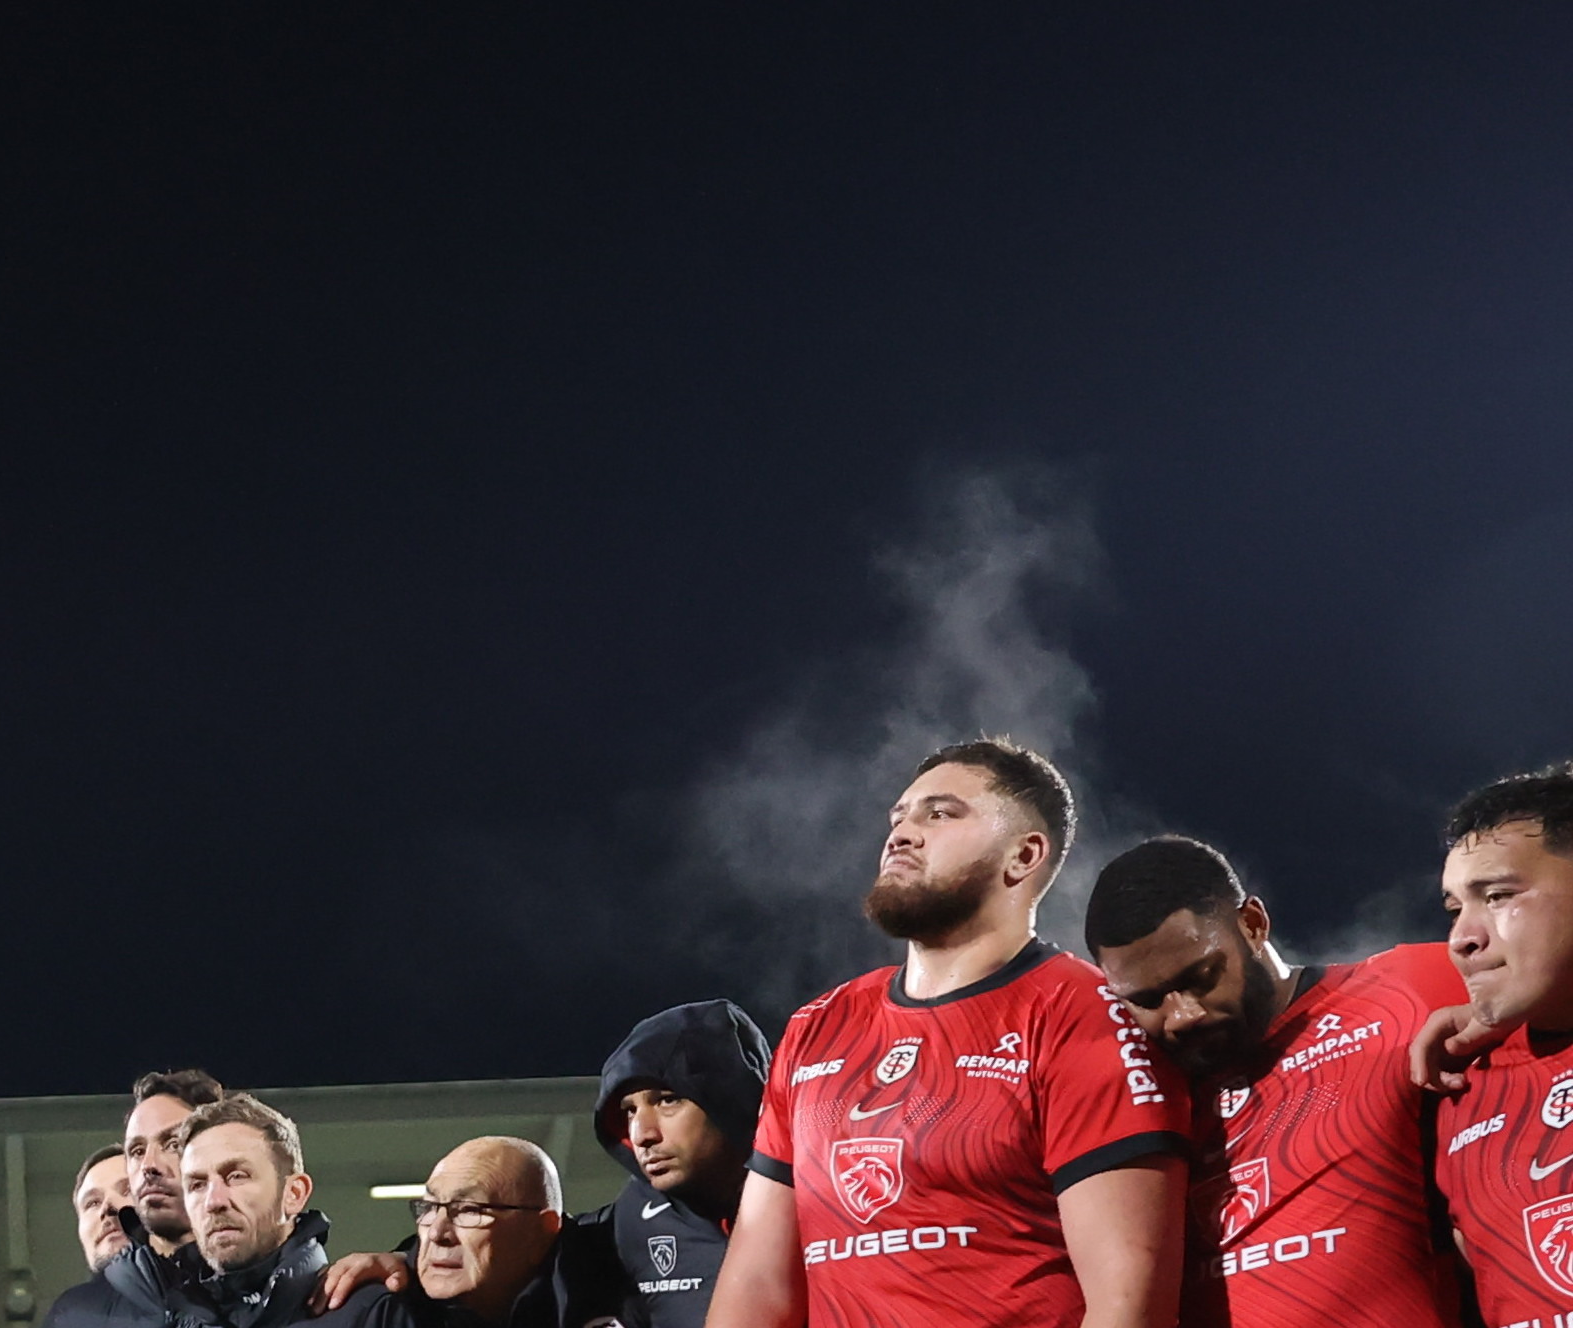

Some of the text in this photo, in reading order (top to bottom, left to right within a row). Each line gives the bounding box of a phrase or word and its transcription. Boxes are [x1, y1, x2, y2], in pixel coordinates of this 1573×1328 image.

[1282, 1021, 1382, 1072] REMPART
[956, 1055, 1031, 1074] REMPAR
[1301, 1044, 1363, 1072] MUTUELLE
[967, 1069, 1020, 1084] MUTUELLE
[1448, 1113, 1507, 1156] AIRBUS
[839, 1144, 896, 1156] PEUGEOT
[1530, 1202, 1573, 1222] PEUG
[1222, 1227, 1347, 1276] GEOT
[638, 1277, 703, 1293] PEUGEOT
